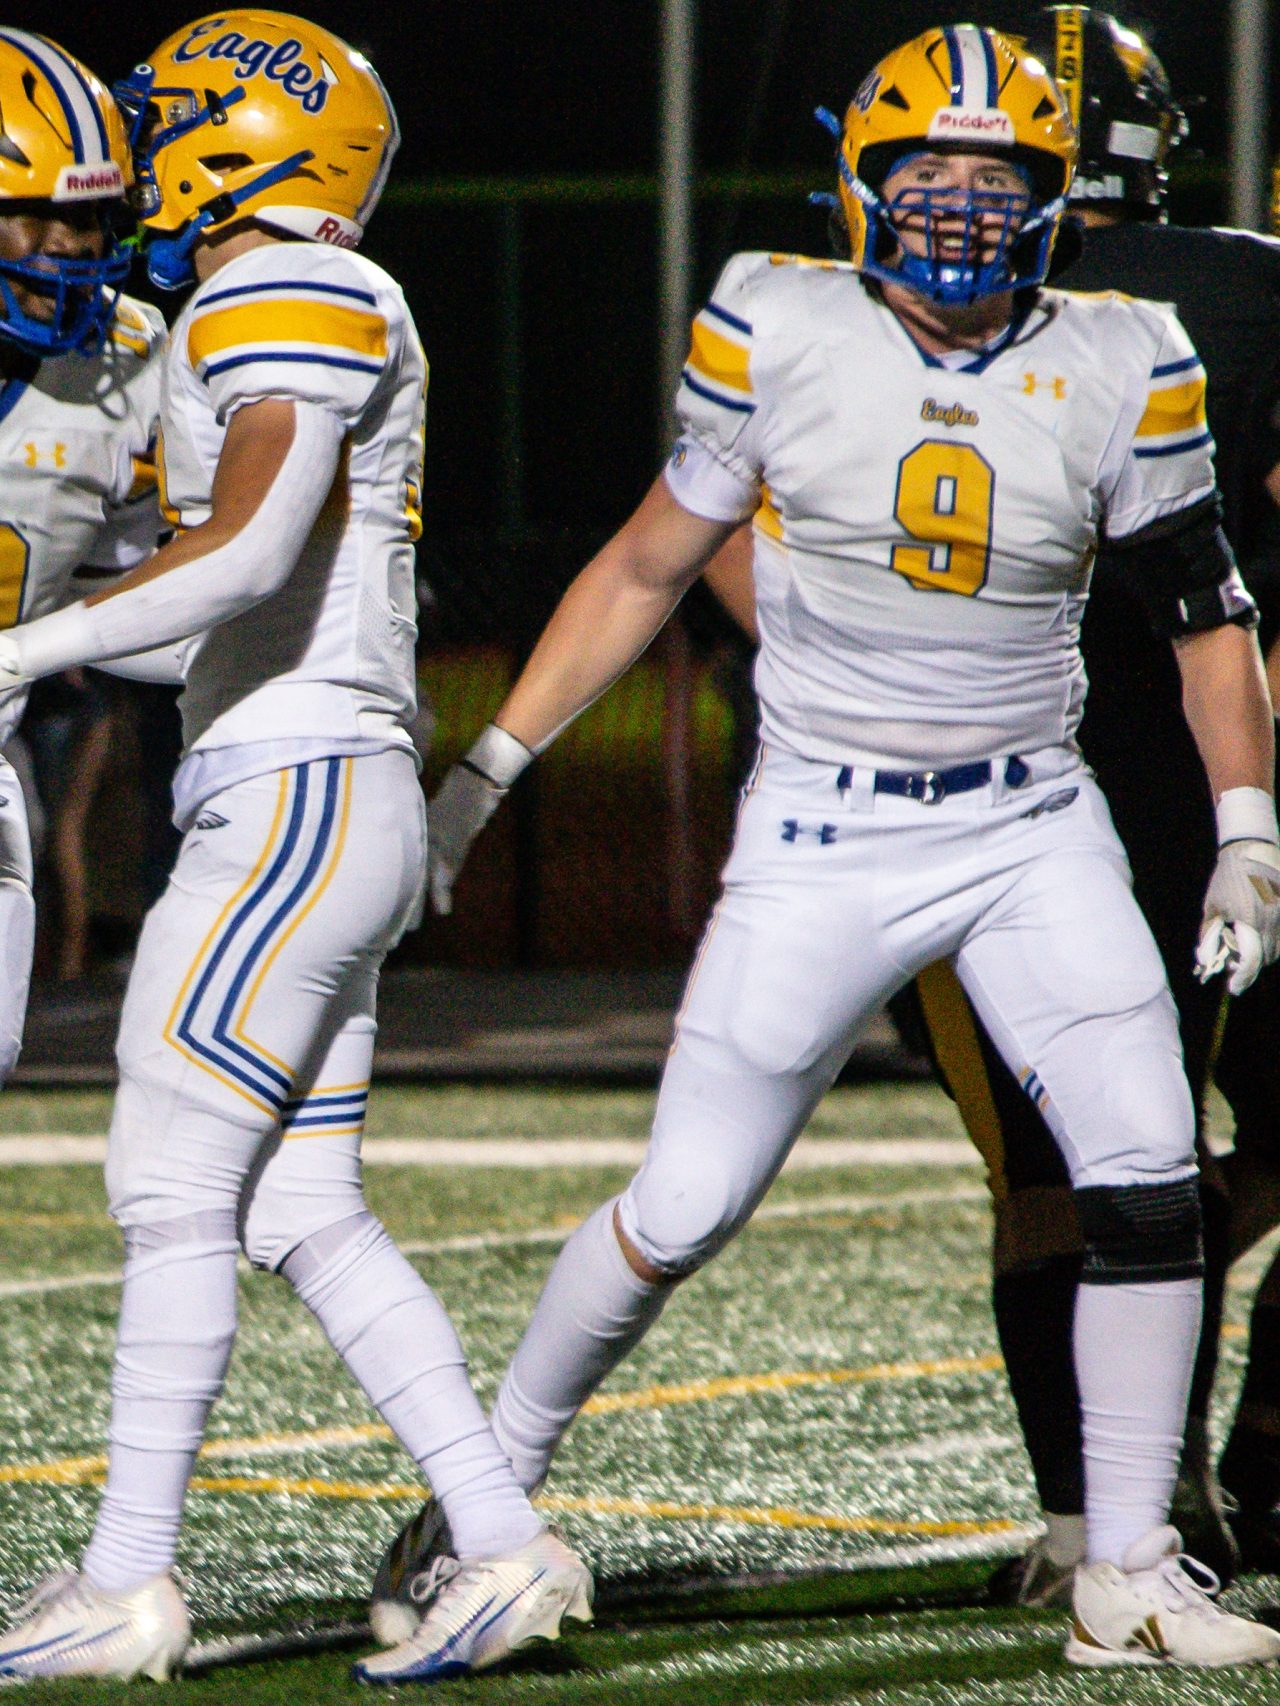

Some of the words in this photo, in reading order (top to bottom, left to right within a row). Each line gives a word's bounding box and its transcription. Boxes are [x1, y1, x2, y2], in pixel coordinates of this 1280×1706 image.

[173, 18, 330, 114] Eagles
[921, 397, 980, 427] Eagles
[889, 438, 996, 599] 9
